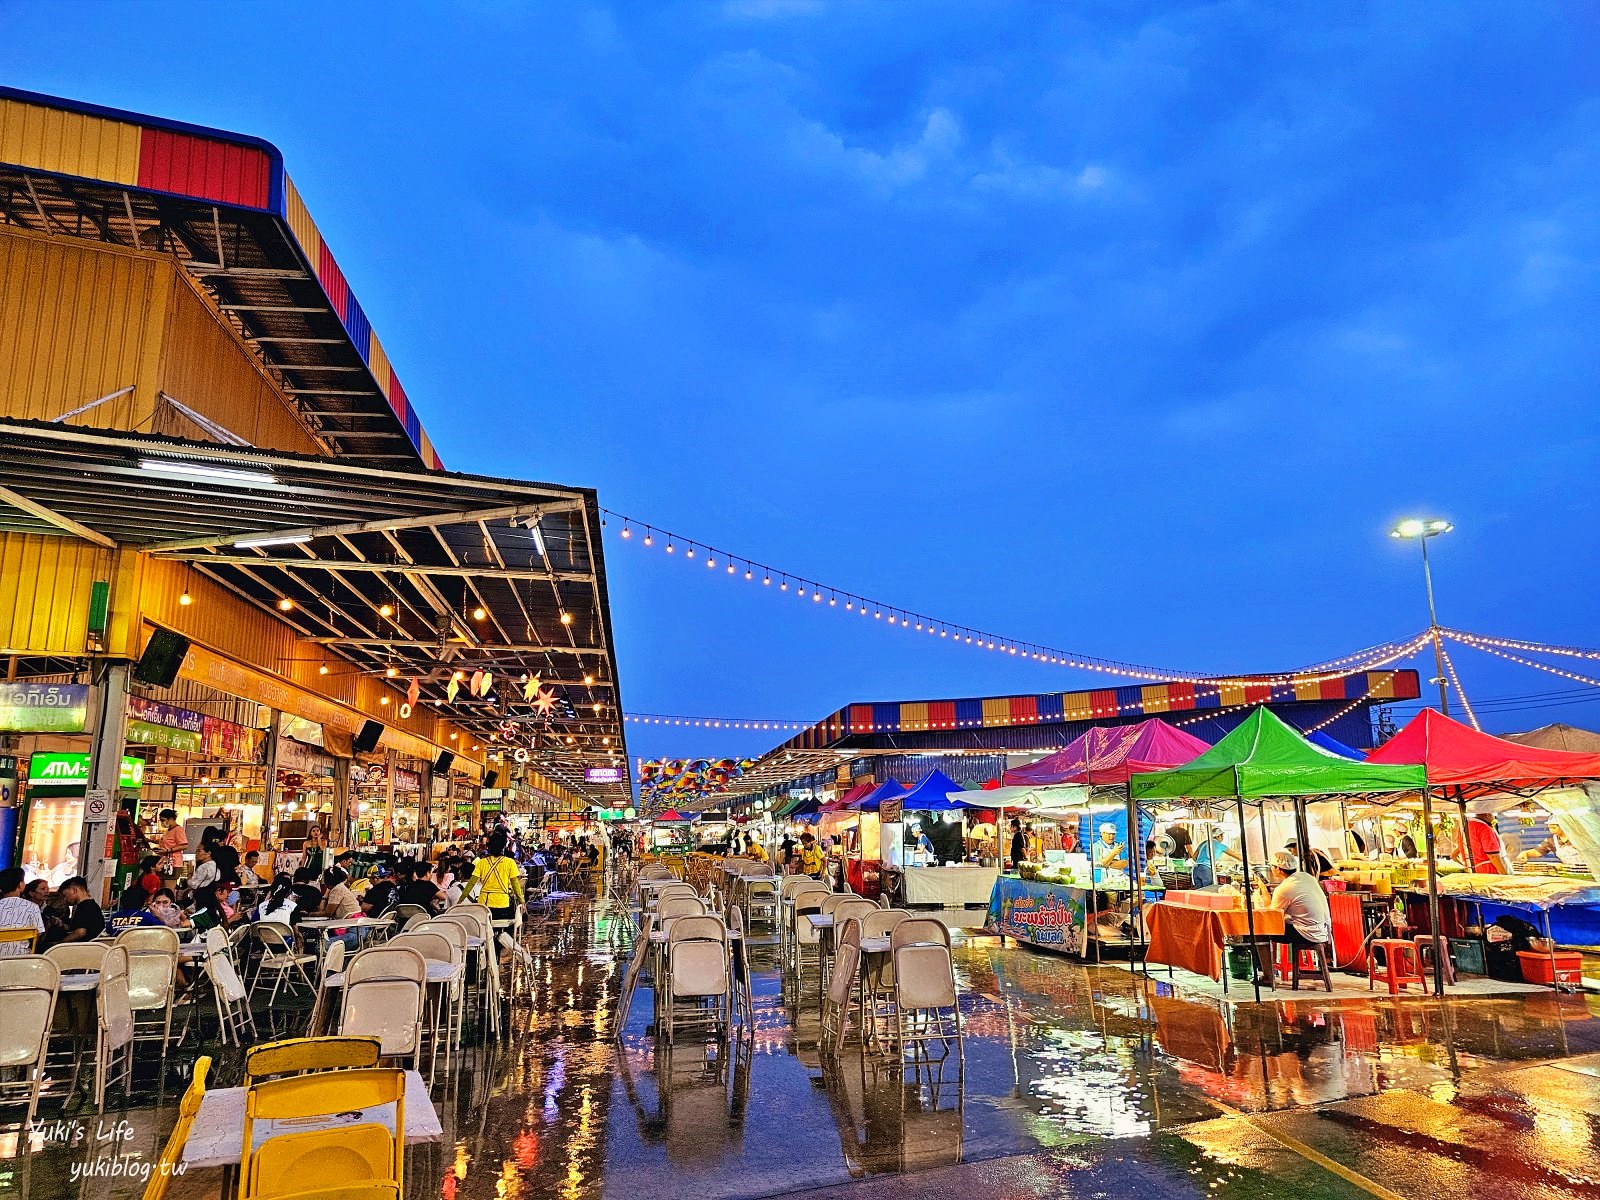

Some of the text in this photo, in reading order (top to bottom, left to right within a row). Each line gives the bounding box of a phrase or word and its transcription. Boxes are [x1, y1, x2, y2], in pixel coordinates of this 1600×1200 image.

[164, 713, 178, 728] ATM
[1013, 899, 1073, 927] มะพร้าวปั่น
[112, 916, 143, 927] STAFF
